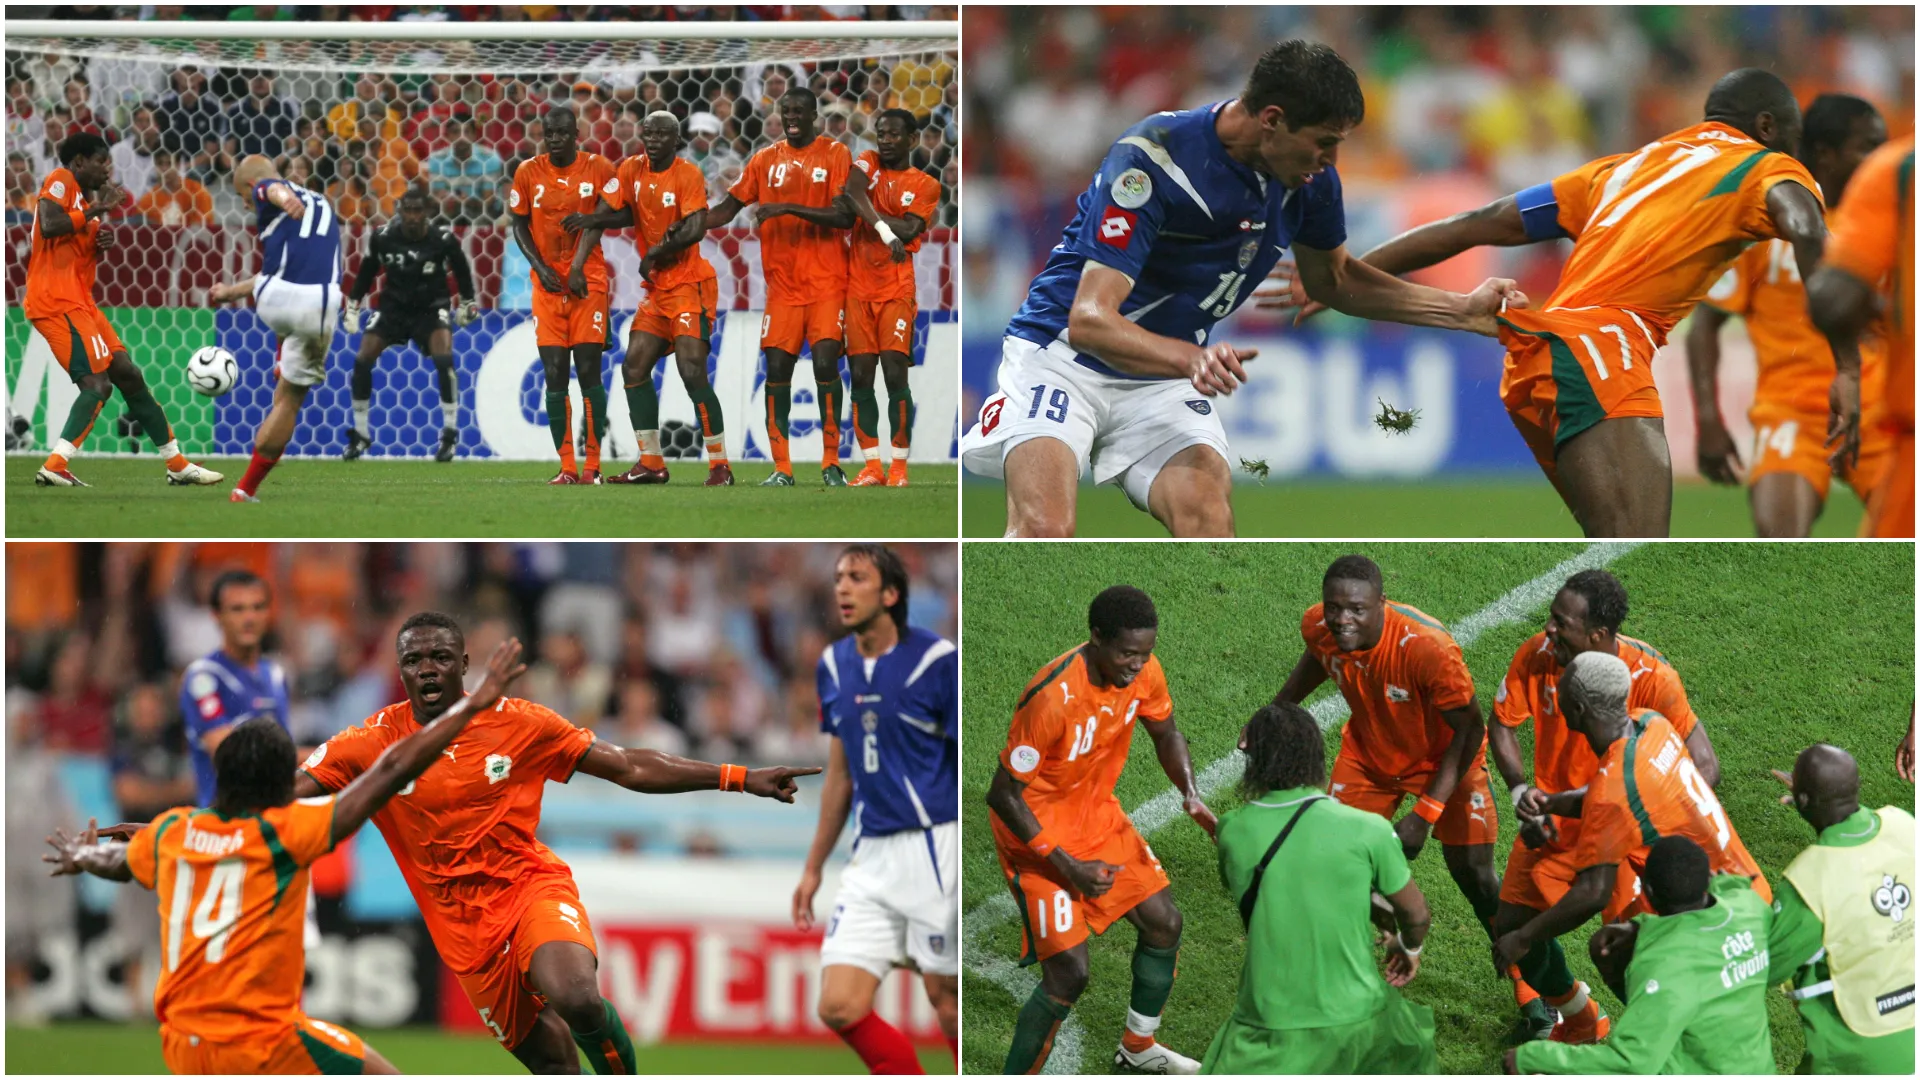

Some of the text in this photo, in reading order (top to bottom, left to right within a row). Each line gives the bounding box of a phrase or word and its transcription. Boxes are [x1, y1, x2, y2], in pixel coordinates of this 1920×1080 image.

[533, 184, 545, 208] 2
[767, 163, 787, 188] 19
[1582, 141, 1722, 234] 17
[1198, 270, 1247, 318] 19
[1578, 324, 1633, 381] 17
[1027, 384, 1070, 424] 19
[863, 733, 880, 774] 6
[1067, 715, 1097, 762] 18
[1679, 757, 1731, 851] 9
[168, 856, 248, 973] 14
[1038, 889, 1073, 938] 18
